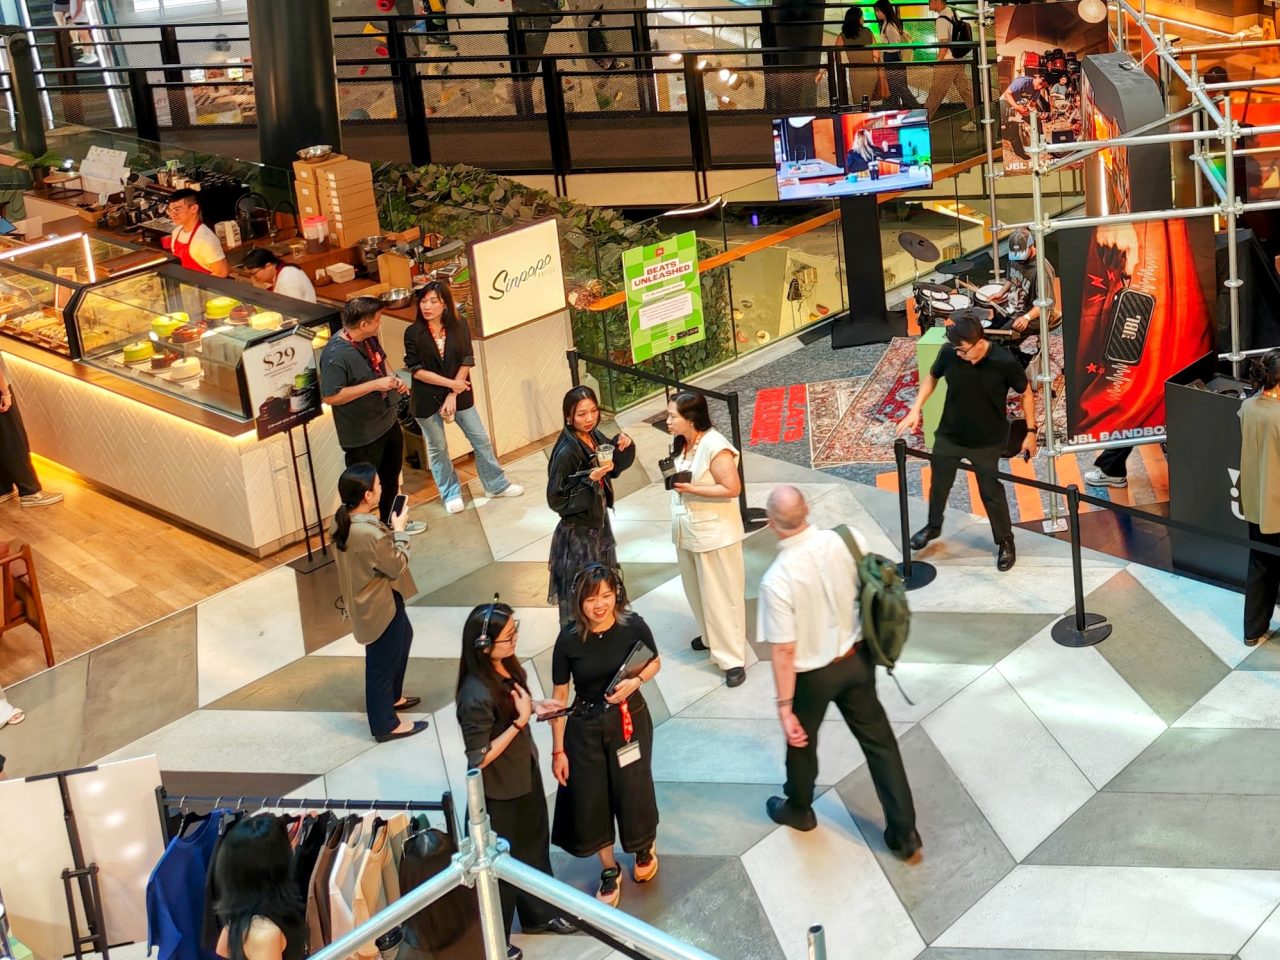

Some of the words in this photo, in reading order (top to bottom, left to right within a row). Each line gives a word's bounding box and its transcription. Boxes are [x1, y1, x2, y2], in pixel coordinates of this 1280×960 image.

[1005, 162, 1027, 171] JBL
[488, 253, 552, 301] Sinpopo
[634, 264, 691, 287] UNLEASHED
[646, 261, 677, 276] BEATS
[1121, 314, 1142, 341] JBL
[263, 346, 296, 371] $29
[1069, 433, 1096, 445] JBL
[1100, 425, 1167, 441] BANDBO
